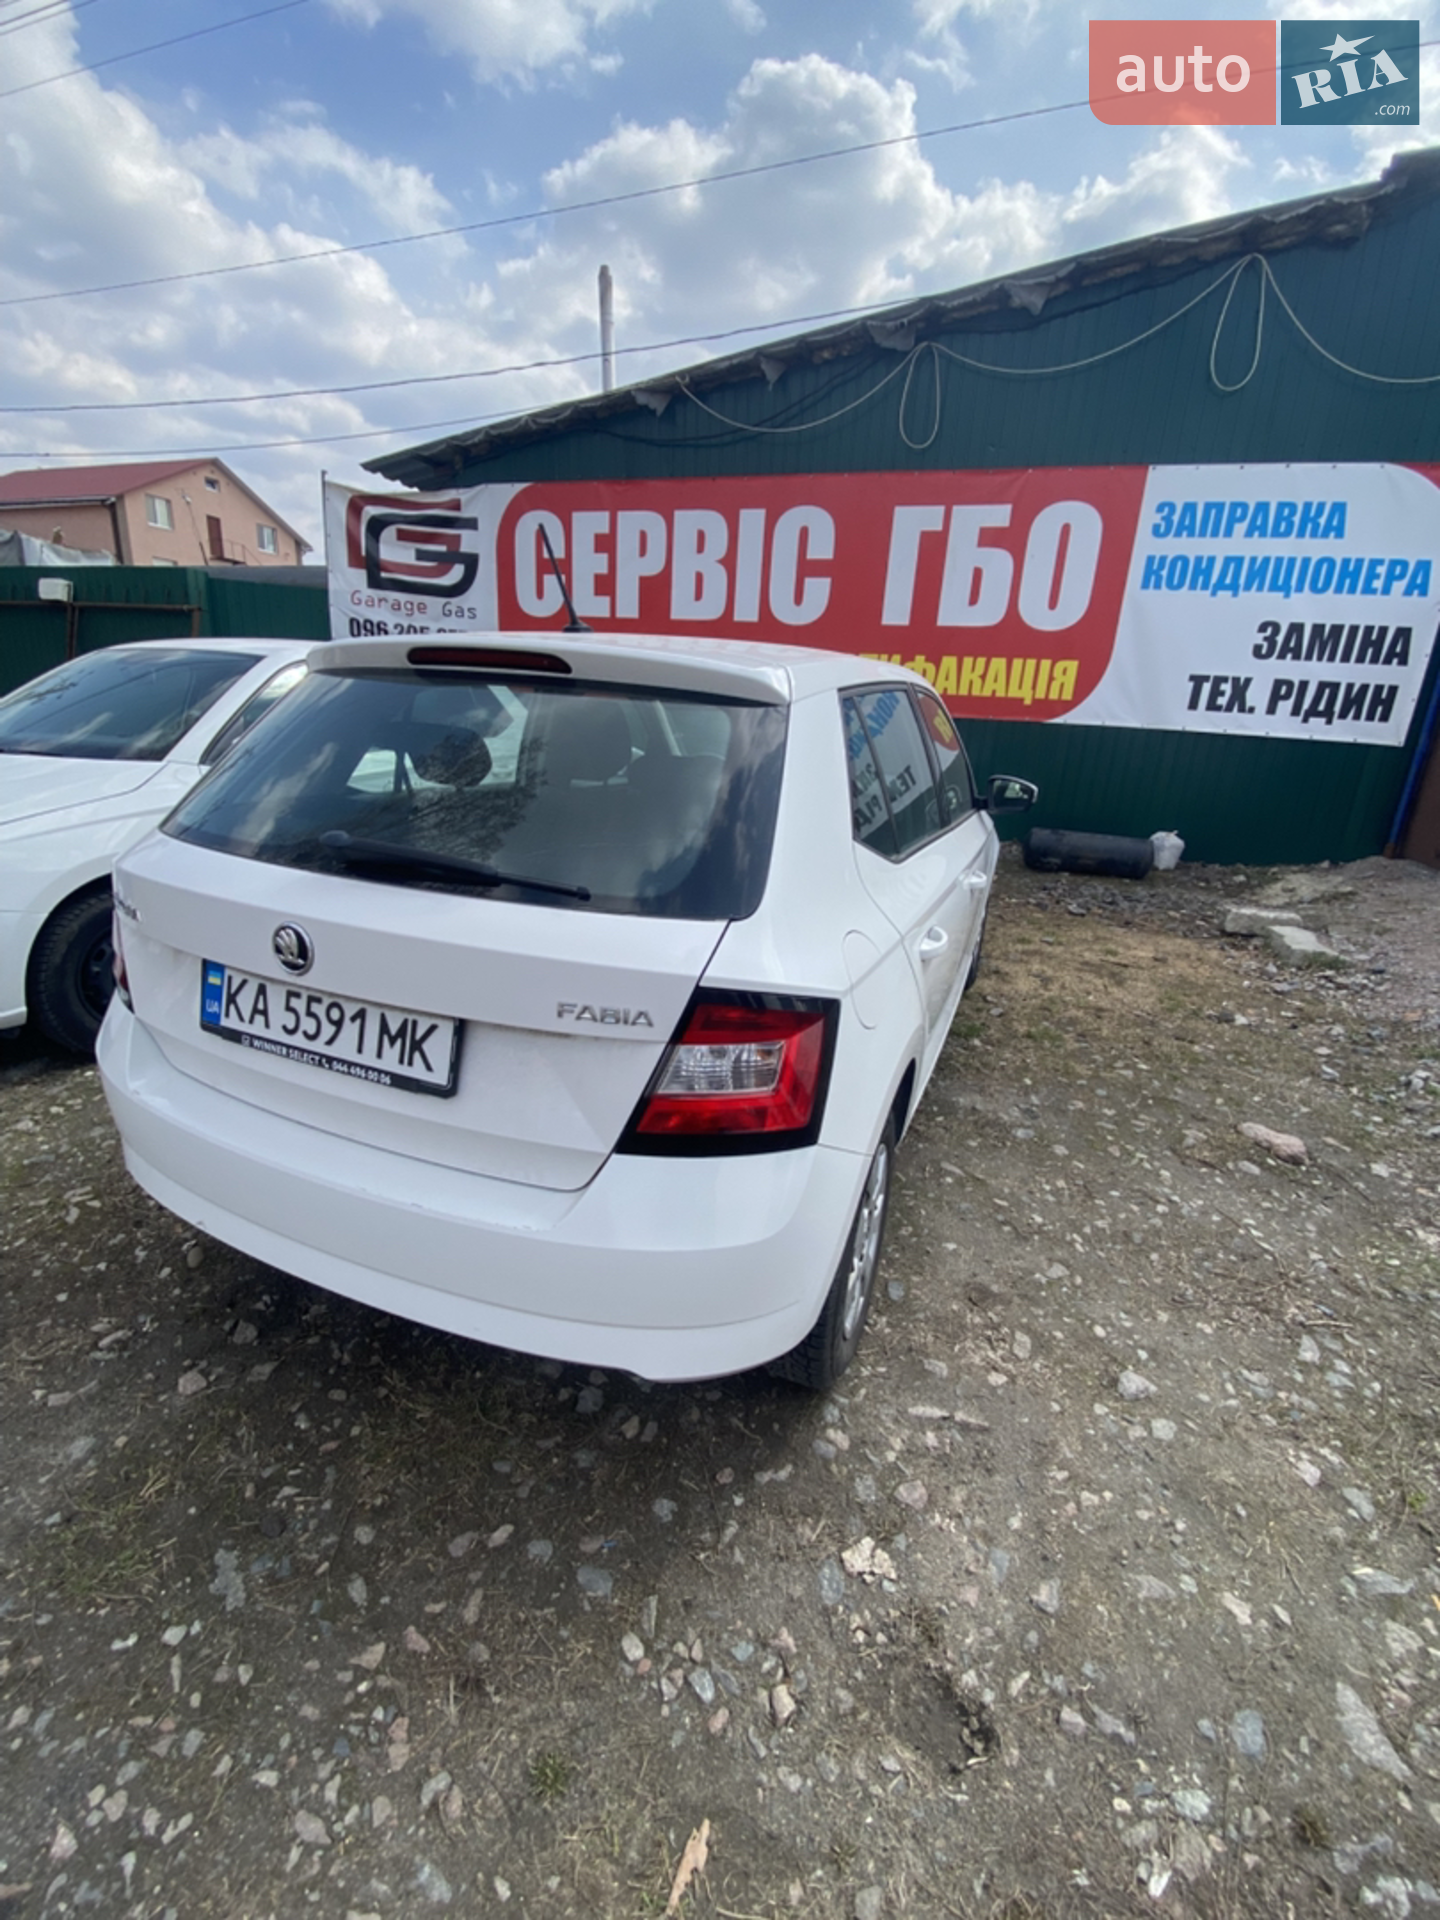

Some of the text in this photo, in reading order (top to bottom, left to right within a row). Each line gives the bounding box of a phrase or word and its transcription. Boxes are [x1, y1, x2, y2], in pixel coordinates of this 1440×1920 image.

[1151, 501, 1348, 539] ЗАПРАВКА
[514, 500, 1103, 632] СЕРВІС ГБО
[1140, 554, 1433, 599] КОНДИЦІОНЕРА
[350, 589, 478, 620] Garage Gas
[1251, 620, 1413, 667] ЗАМІНА
[1187, 674, 1400, 725] ТЕХ. РІДИН
[205, 998, 219, 1014] UA
[224, 974, 439, 1073] KA 5591 MK
[557, 1001, 654, 1028] FABIA
[252, 1038, 289, 1057] WINNER
[289, 1048, 320, 1066] SELECT
